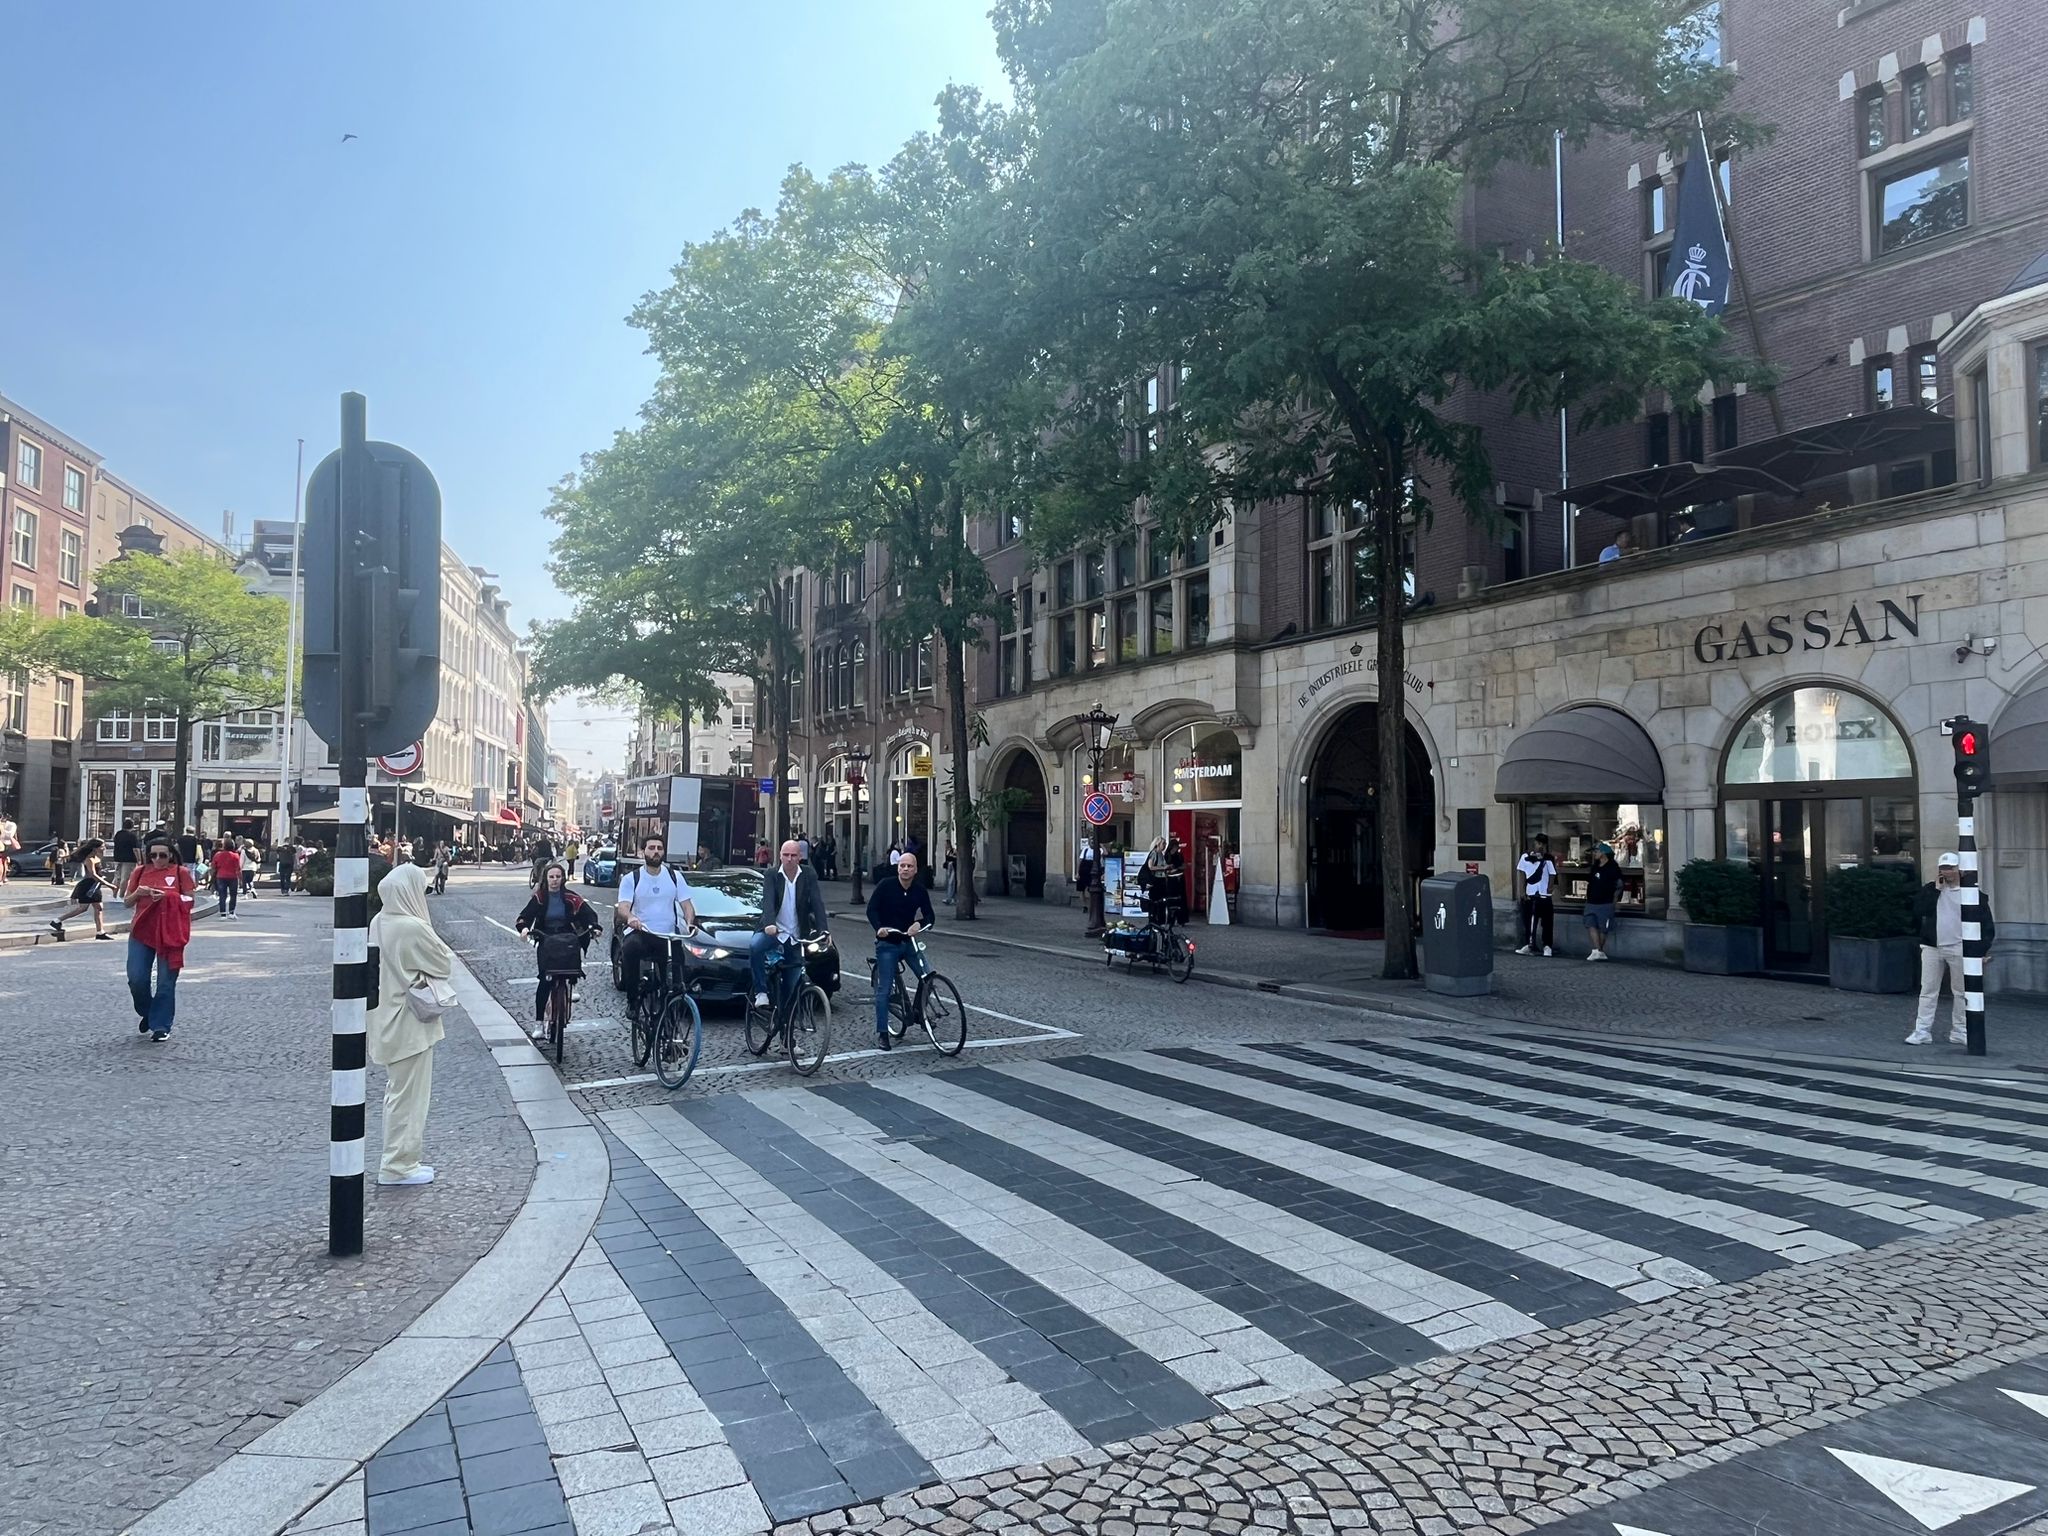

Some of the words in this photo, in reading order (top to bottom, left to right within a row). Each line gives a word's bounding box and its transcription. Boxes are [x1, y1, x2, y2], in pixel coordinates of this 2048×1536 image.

[1694, 594, 1924, 664] GASSAN
[1298, 691, 1310, 708] DE
[1308, 659, 1364, 697] INDUSTRIEELE
[1174, 763, 1233, 780] AMSTERDAM
